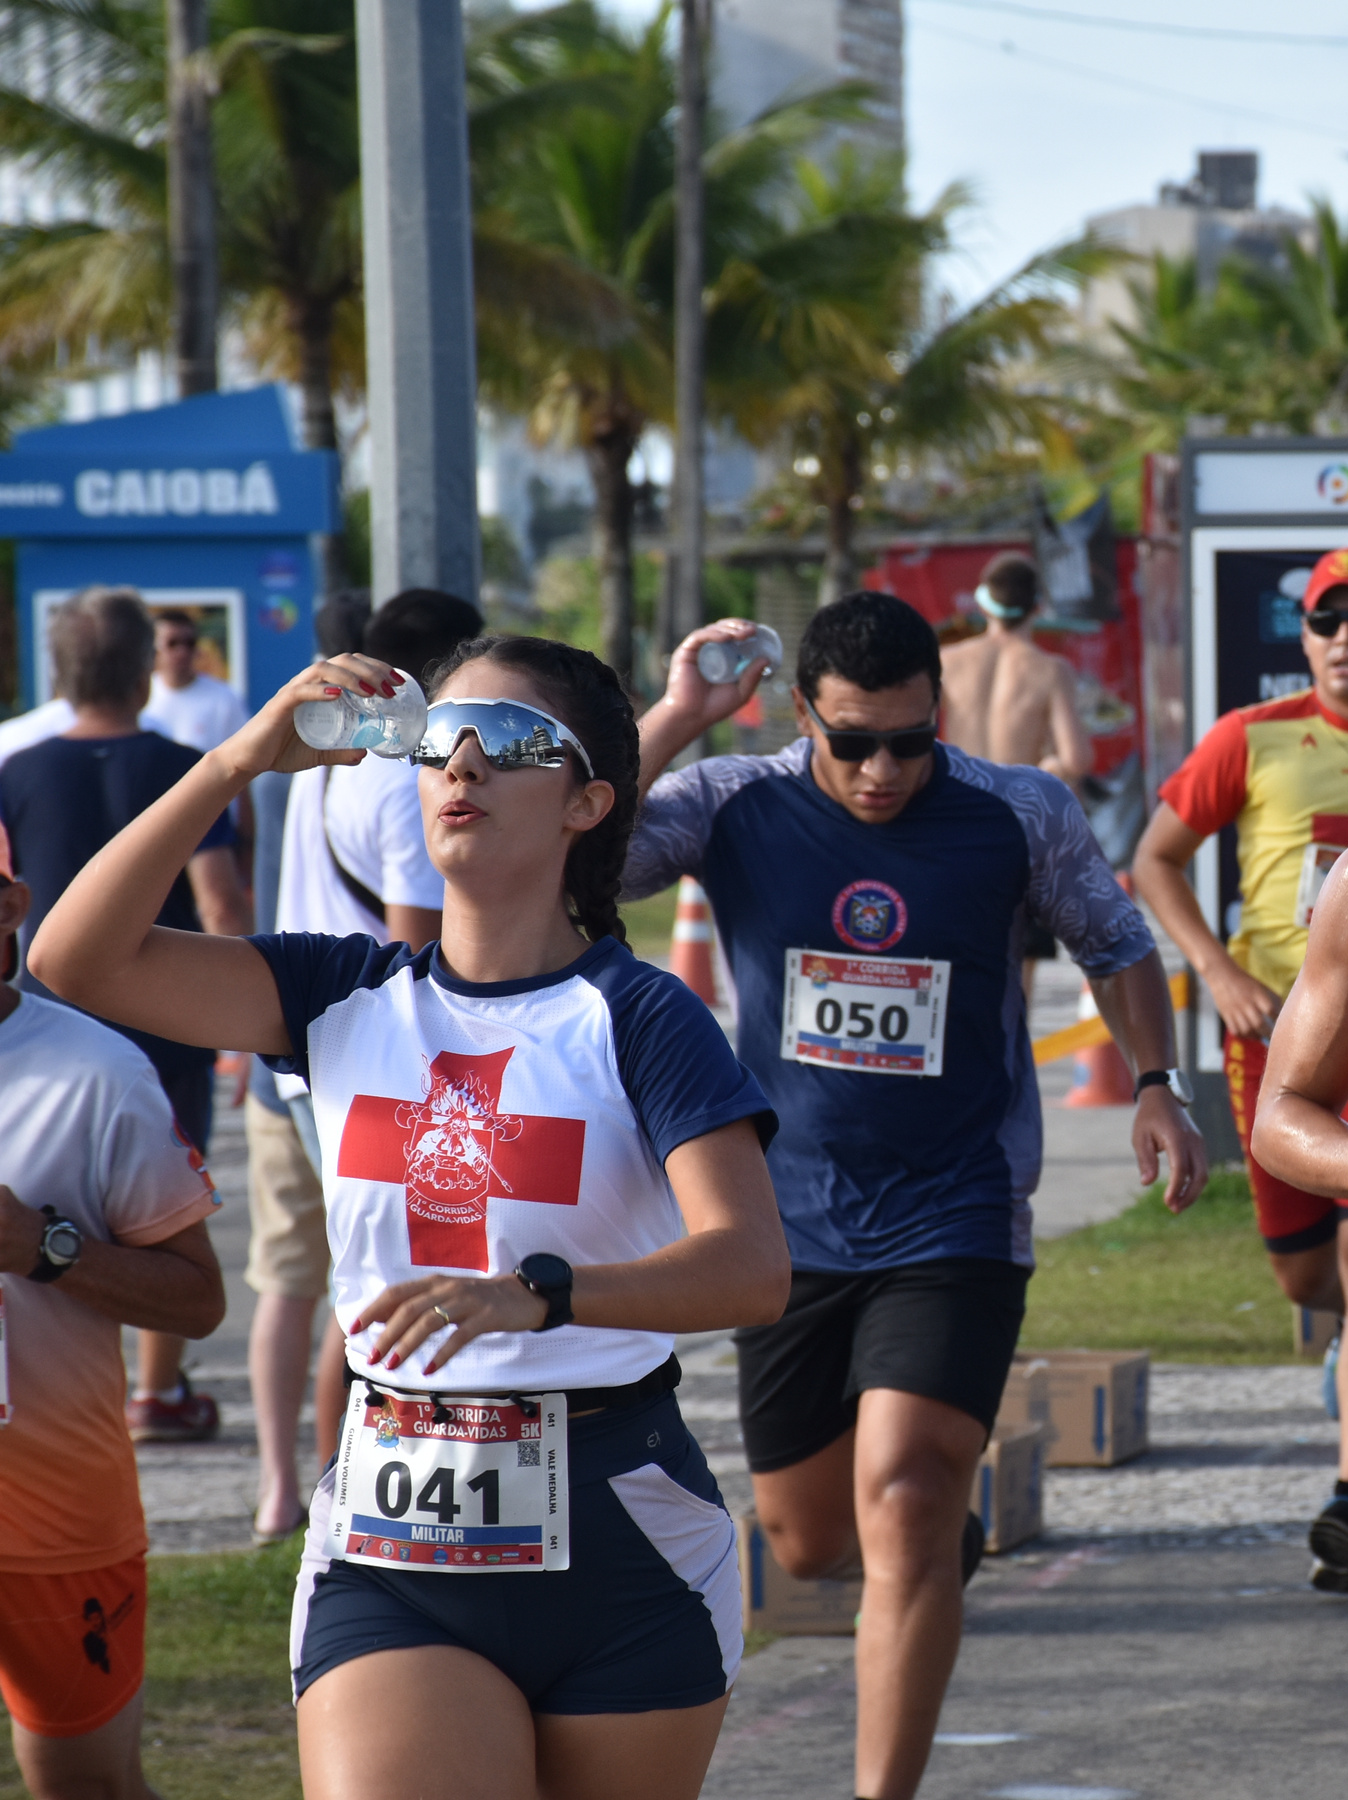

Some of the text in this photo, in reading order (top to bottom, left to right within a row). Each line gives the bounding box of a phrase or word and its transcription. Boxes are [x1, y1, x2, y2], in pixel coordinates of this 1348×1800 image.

[75, 461, 279, 517] CAIOBÁ
[859, 962, 908, 976] CORRIDA
[816, 998, 909, 1043] 050
[409, 1203, 482, 1224] GUARDA-VIDAS
[428, 1203, 475, 1215] CORRIDA
[353, 1397, 362, 1412] 041
[417, 1405, 501, 1423] 1ª ORRIDA
[547, 1412, 555, 1428] 041
[413, 1421, 507, 1440] GUARDA-VIDAS
[521, 1423, 541, 1438] 5K
[339, 1428, 355, 1506] GUARDA VOLUMES
[547, 1449, 557, 1515] VALE MEDALHA
[375, 1461, 500, 1526] 041
[333, 1522, 342, 1538] 041
[411, 1525, 464, 1543] MILITAR
[549, 1535, 558, 1550] 041
